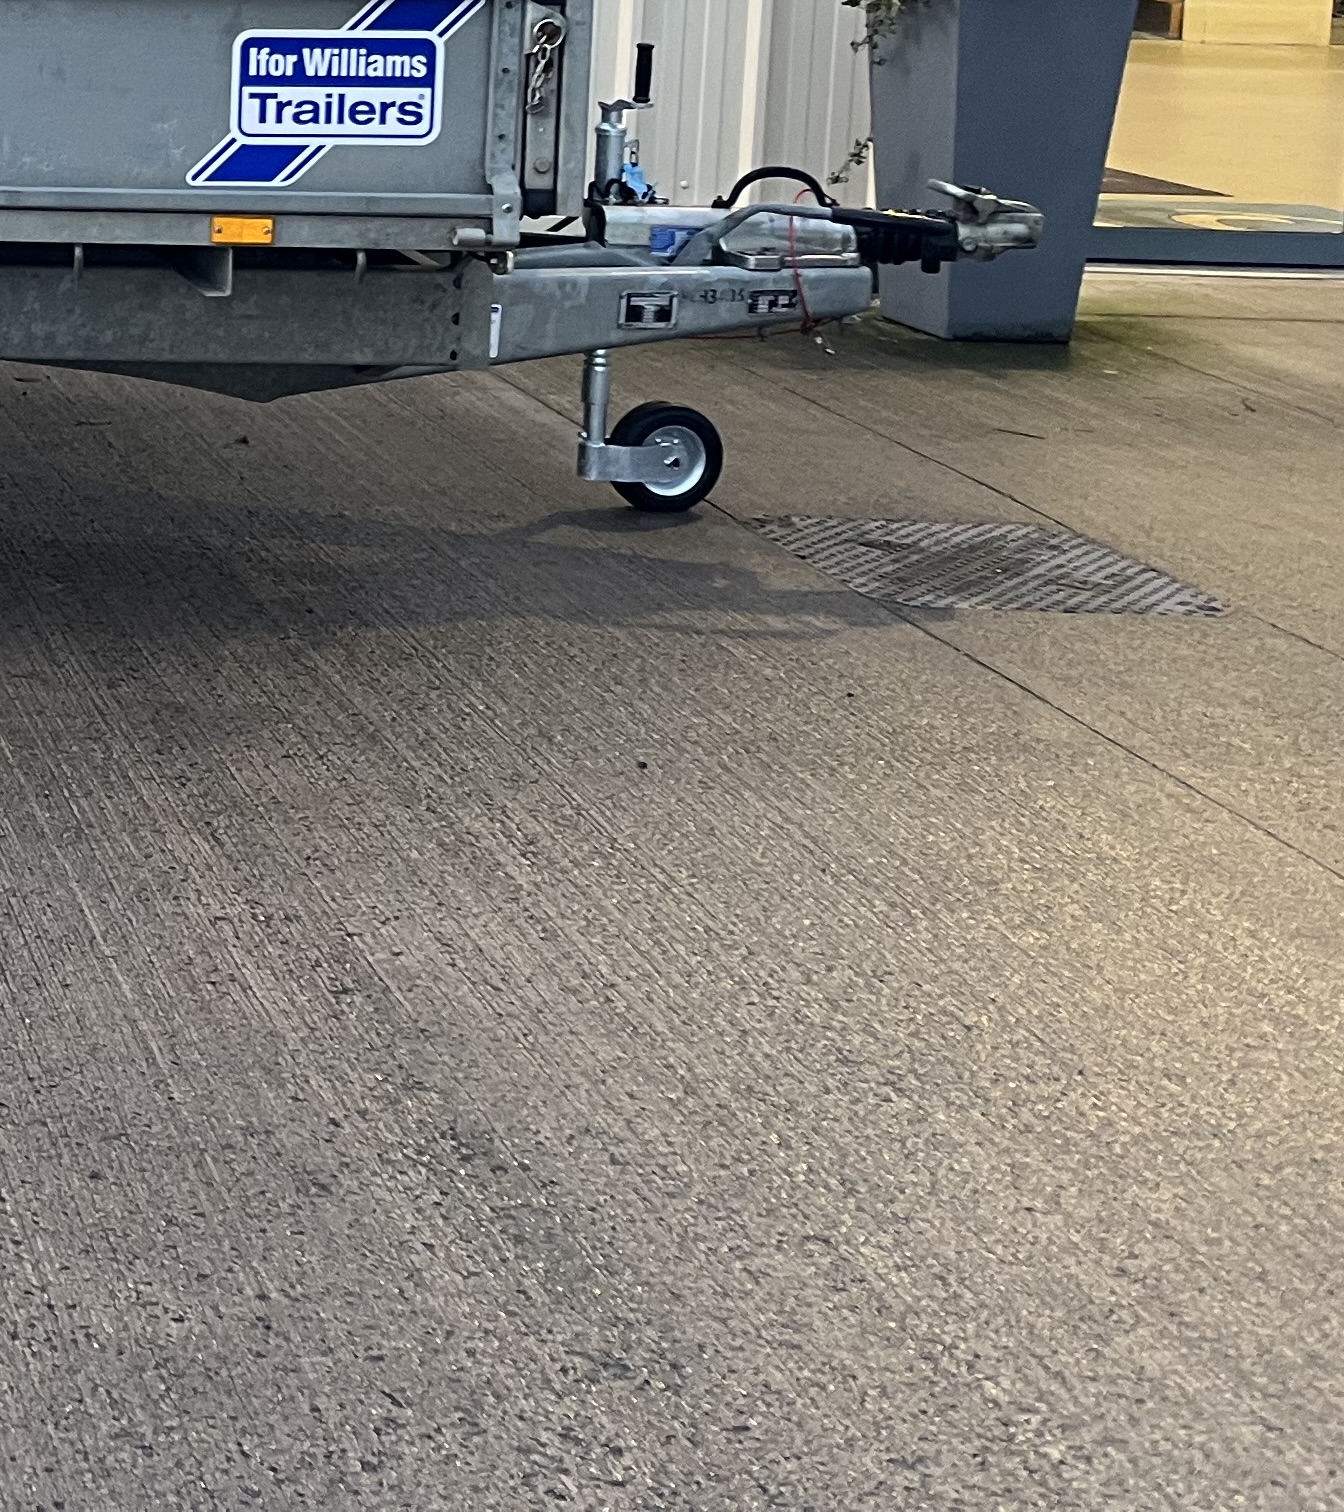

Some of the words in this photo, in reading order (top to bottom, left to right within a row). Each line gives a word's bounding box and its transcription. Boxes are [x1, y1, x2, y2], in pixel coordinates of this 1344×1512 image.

[248, 47, 298, 77] Ifor
[302, 47, 428, 78] Williams
[248, 92, 425, 126] Trailers
